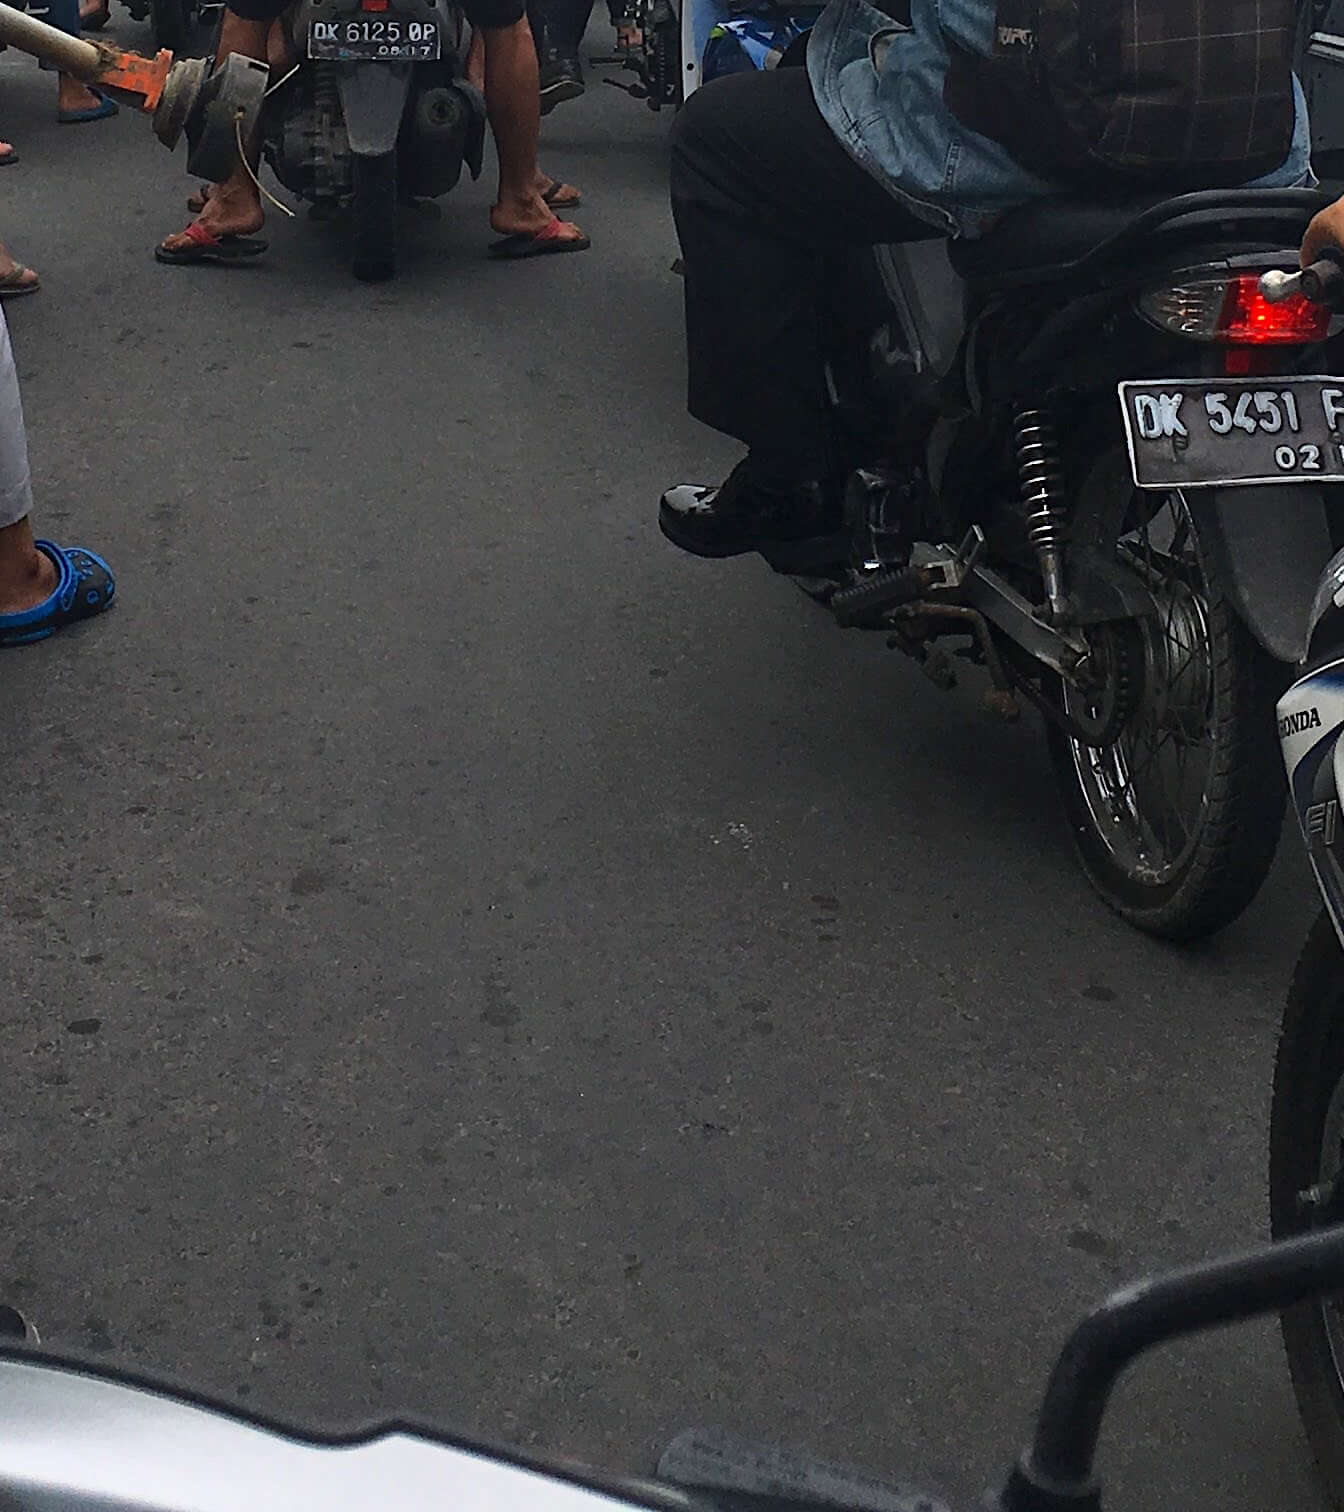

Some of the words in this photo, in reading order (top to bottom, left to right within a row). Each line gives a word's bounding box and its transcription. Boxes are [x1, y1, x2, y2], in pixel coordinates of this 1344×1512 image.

[314, 22, 340, 40] DK
[346, 22, 400, 42] 6125
[1134, 392, 1188, 438] DK
[1205, 391, 1300, 434] 5451
[1275, 445, 1320, 470] 02
